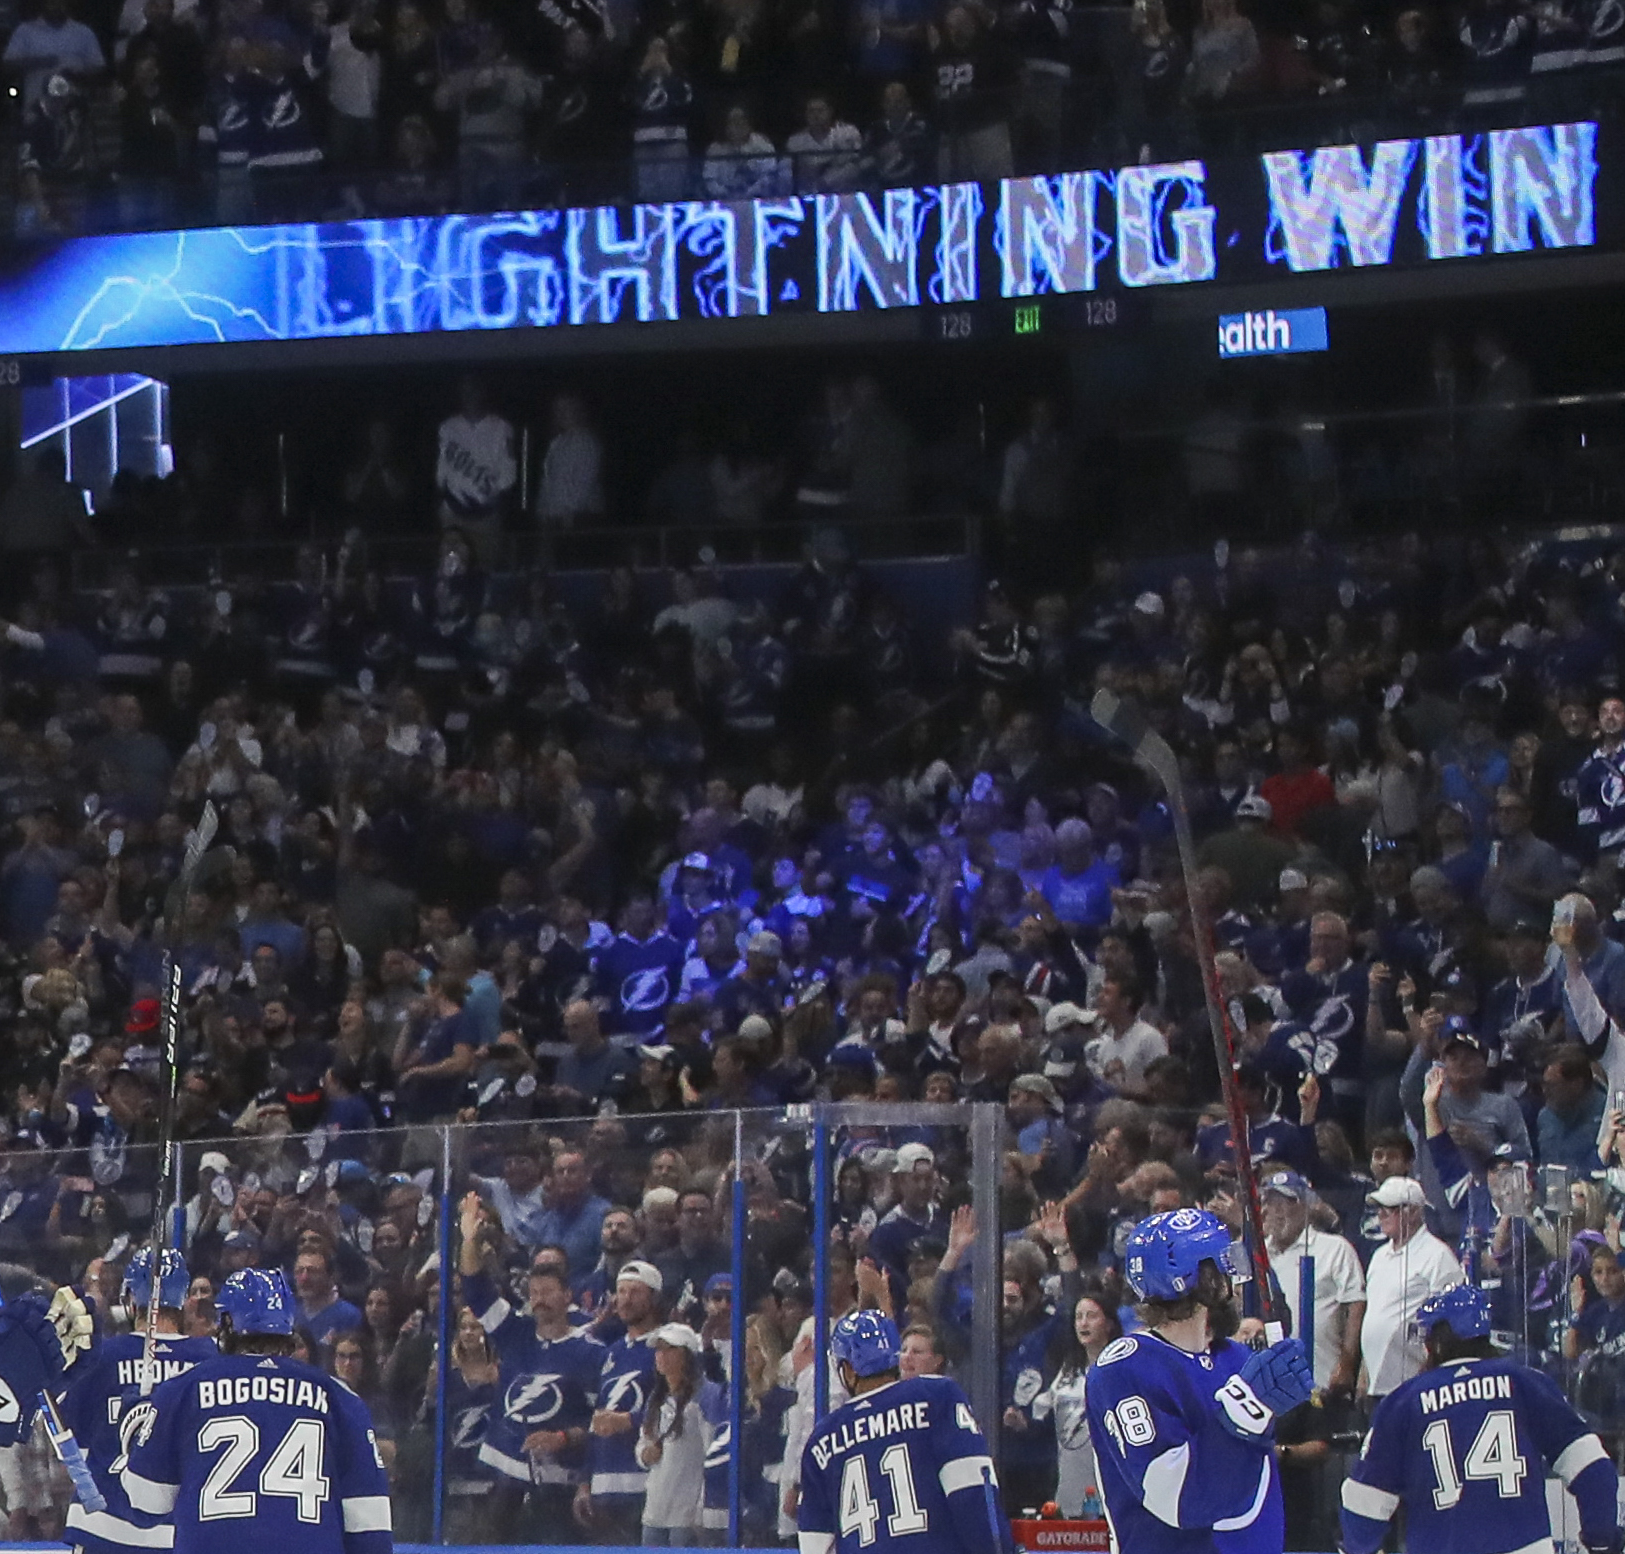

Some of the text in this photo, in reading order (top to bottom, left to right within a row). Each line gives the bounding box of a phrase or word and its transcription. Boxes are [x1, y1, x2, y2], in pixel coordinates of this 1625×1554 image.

[1262, 122, 1597, 273] WIN
[267, 1297, 283, 1311] 24
[877, 1337, 890, 1351] 41
[199, 1376, 330, 1415] BOGOSIAN
[1420, 1375, 1513, 1415] MAROON
[811, 1400, 931, 1471] BELLEMARE
[1422, 1409, 1528, 1512] 14
[198, 1415, 330, 1525] 24
[839, 1442, 929, 1550] 41
[1036, 1530, 1110, 1547] GATORADE
